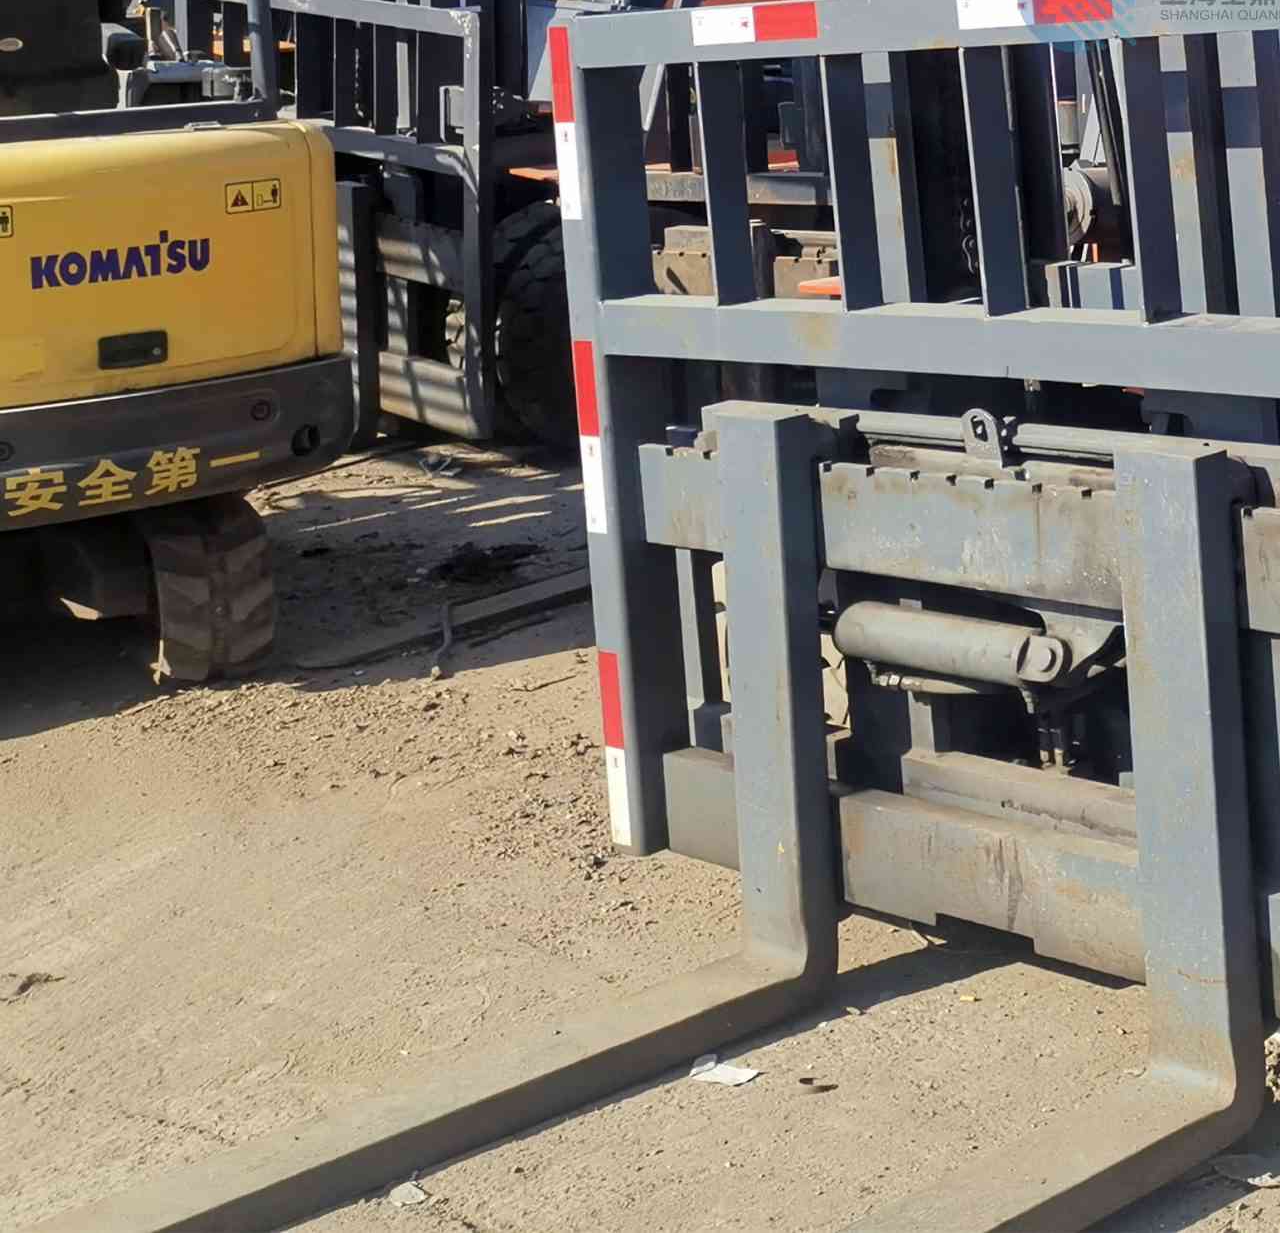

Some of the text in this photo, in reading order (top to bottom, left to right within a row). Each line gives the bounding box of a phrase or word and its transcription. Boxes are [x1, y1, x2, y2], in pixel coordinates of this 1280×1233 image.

[29, 229, 211, 290] KOMATSU
[4, 446, 261, 517] 安全第一
